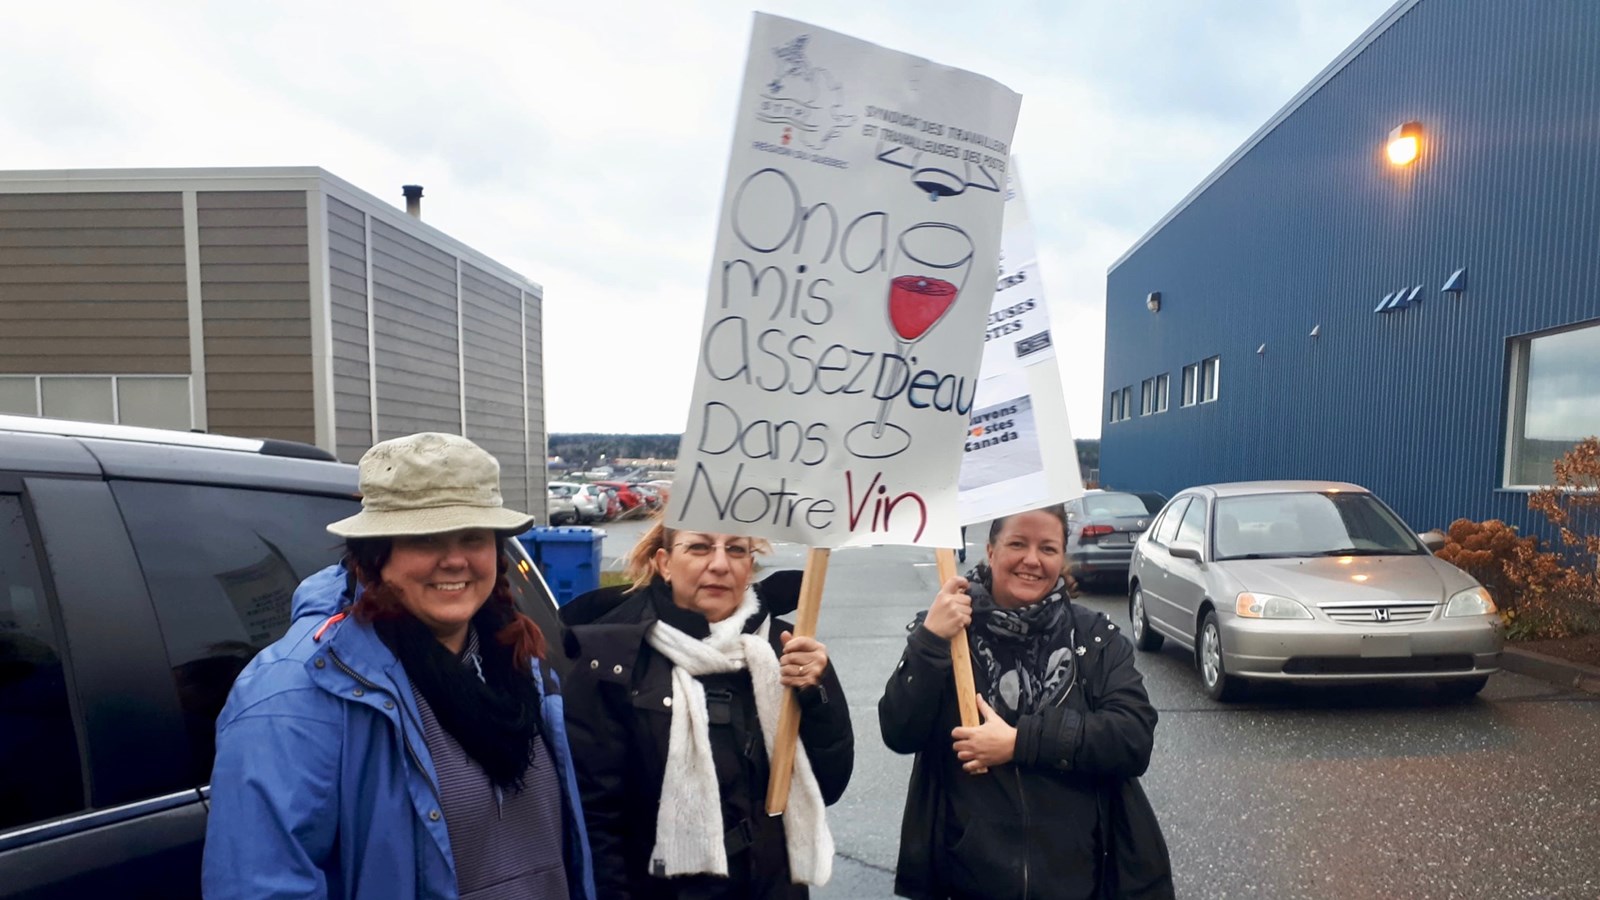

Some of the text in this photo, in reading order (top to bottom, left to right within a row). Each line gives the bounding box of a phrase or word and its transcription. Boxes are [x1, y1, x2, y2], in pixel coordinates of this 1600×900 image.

[862, 124, 879, 137] ET
[963, 149, 981, 164] DES
[920, 120, 944, 136] DES
[721, 259, 833, 326] mis
[698, 401, 829, 467] Dans
[970, 404, 1018, 427] uvons
[964, 431, 1019, 453] Canada
[678, 461, 928, 543] Notre Vin
